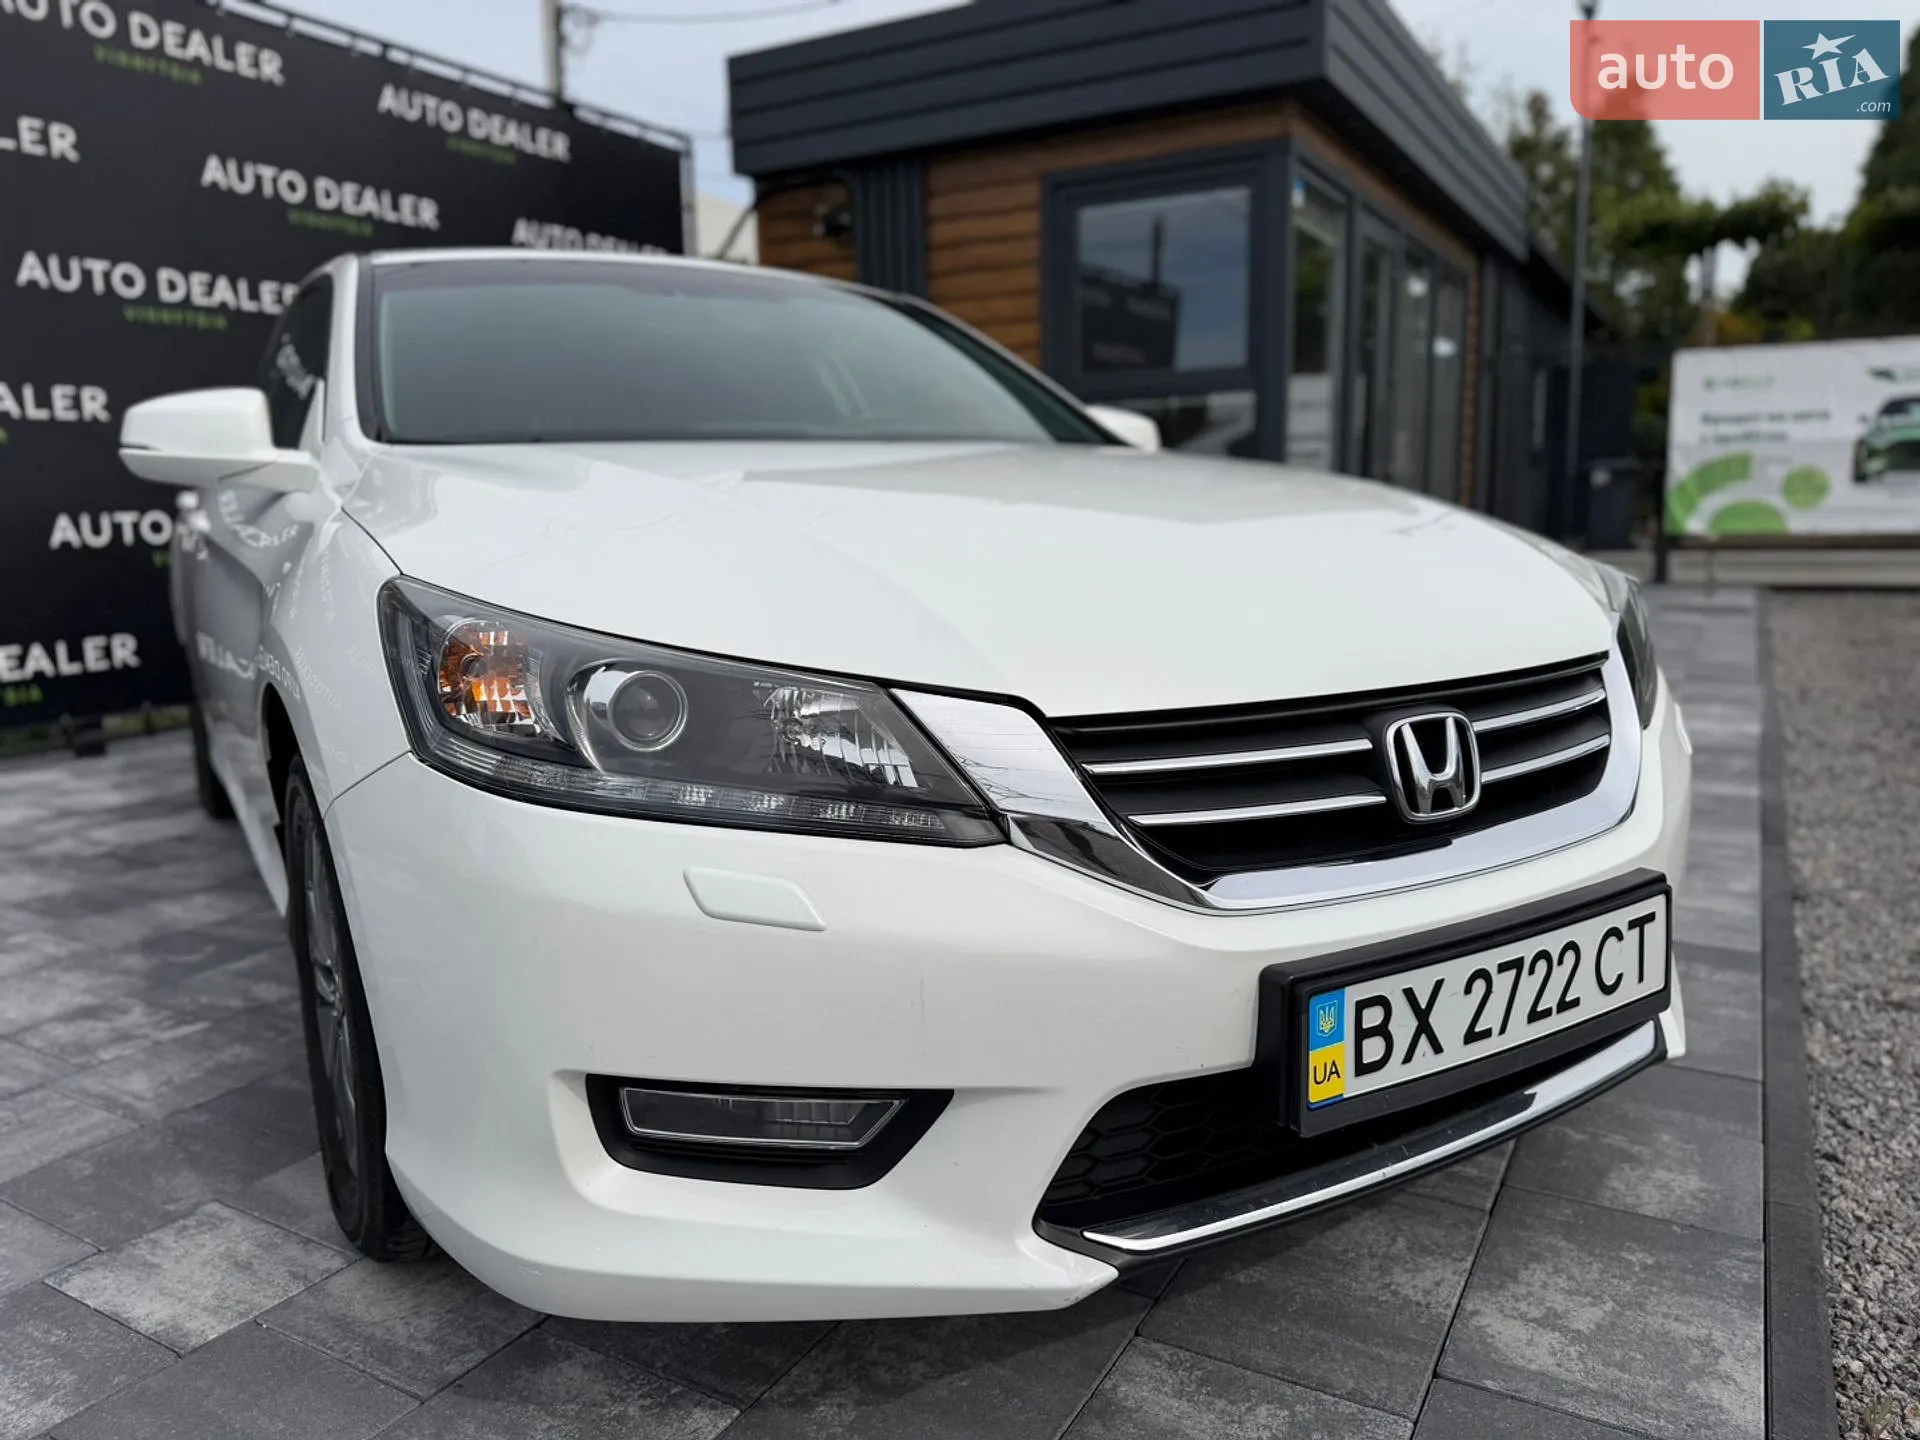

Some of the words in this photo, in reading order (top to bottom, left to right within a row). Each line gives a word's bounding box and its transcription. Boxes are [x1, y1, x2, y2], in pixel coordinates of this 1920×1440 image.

[0, 0, 117, 39] UTO
[127, 10, 286, 86] DEALER
[377, 83, 464, 133] AUTO
[466, 107, 572, 163] DEALER
[201, 153, 308, 205] AUTO
[313, 176, 440, 231] DEALER
[16, 250, 147, 300] AUTO
[49, 508, 174, 550] AUTO
[1353, 976, 1446, 1078] BX
[1462, 939, 1582, 1047] 2722
[1594, 910, 1657, 997] CT
[1312, 1059, 1342, 1087] UA
